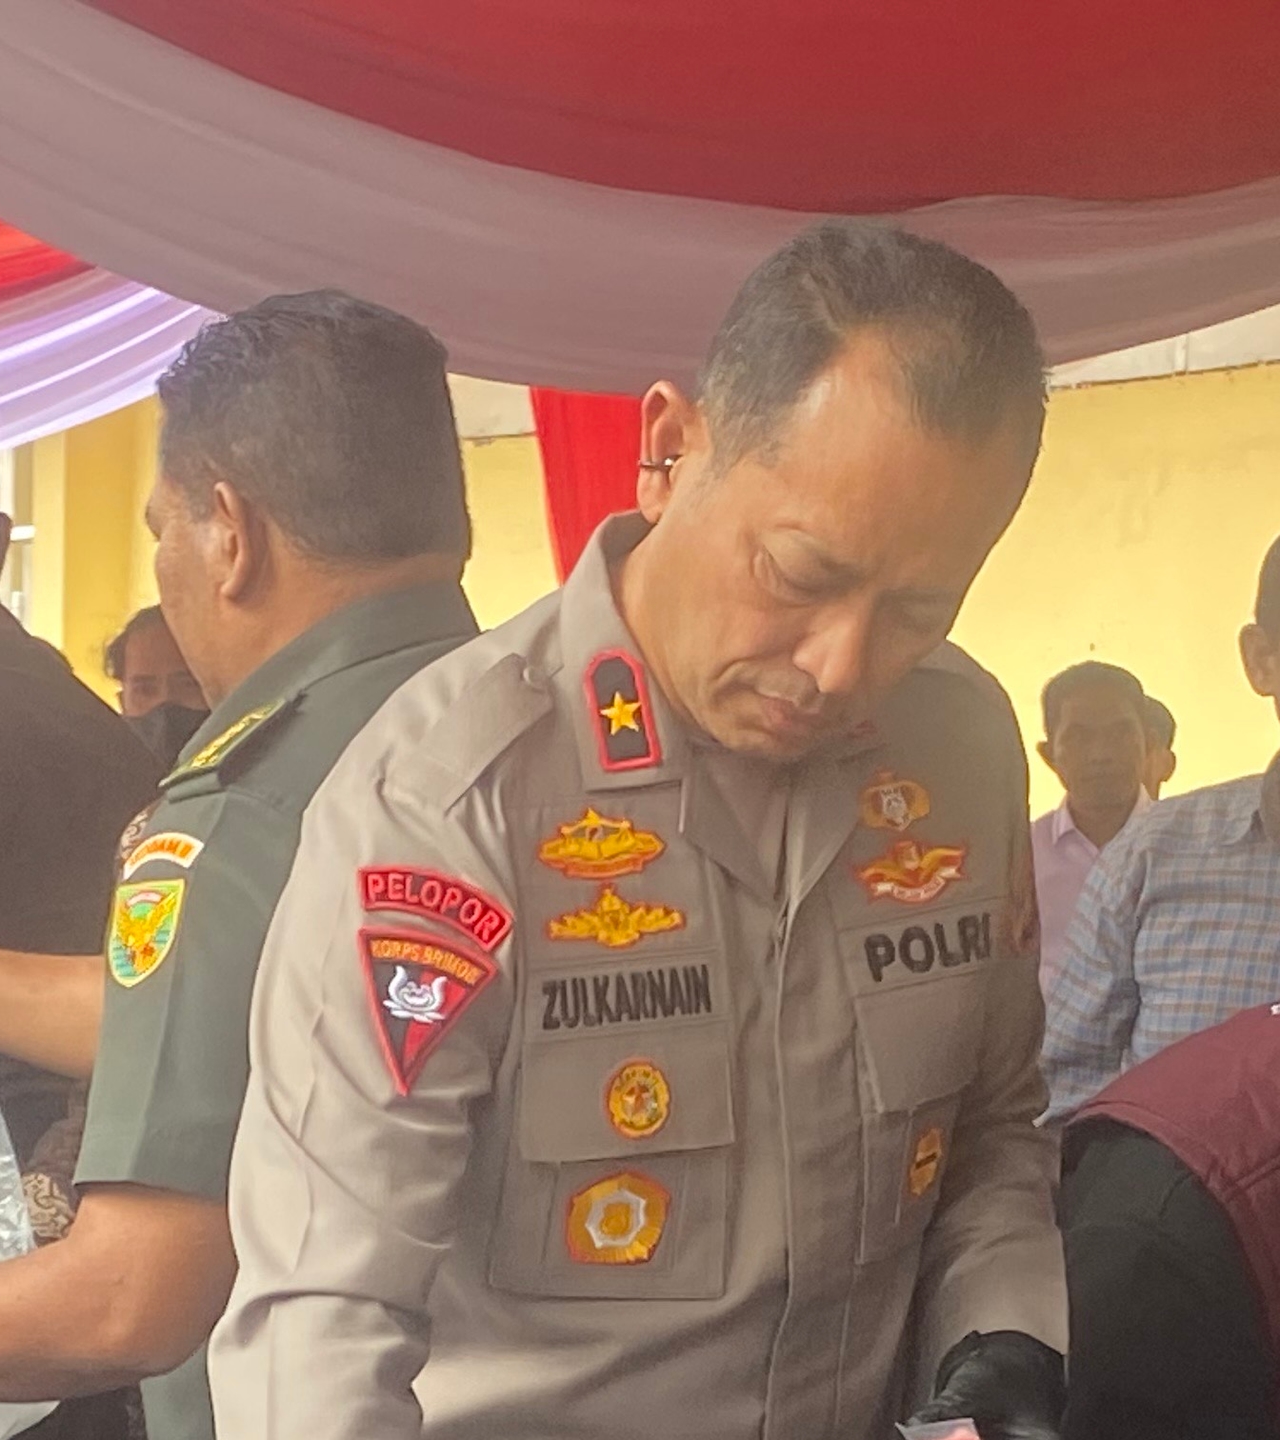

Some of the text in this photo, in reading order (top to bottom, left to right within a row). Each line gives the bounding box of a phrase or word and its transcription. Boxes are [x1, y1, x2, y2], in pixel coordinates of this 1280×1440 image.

[367, 872, 501, 941] PELOPOR
[371, 940, 420, 962] KORPS
[863, 912, 991, 983] POLRI
[541, 963, 712, 1031] ZULKARNAIN
